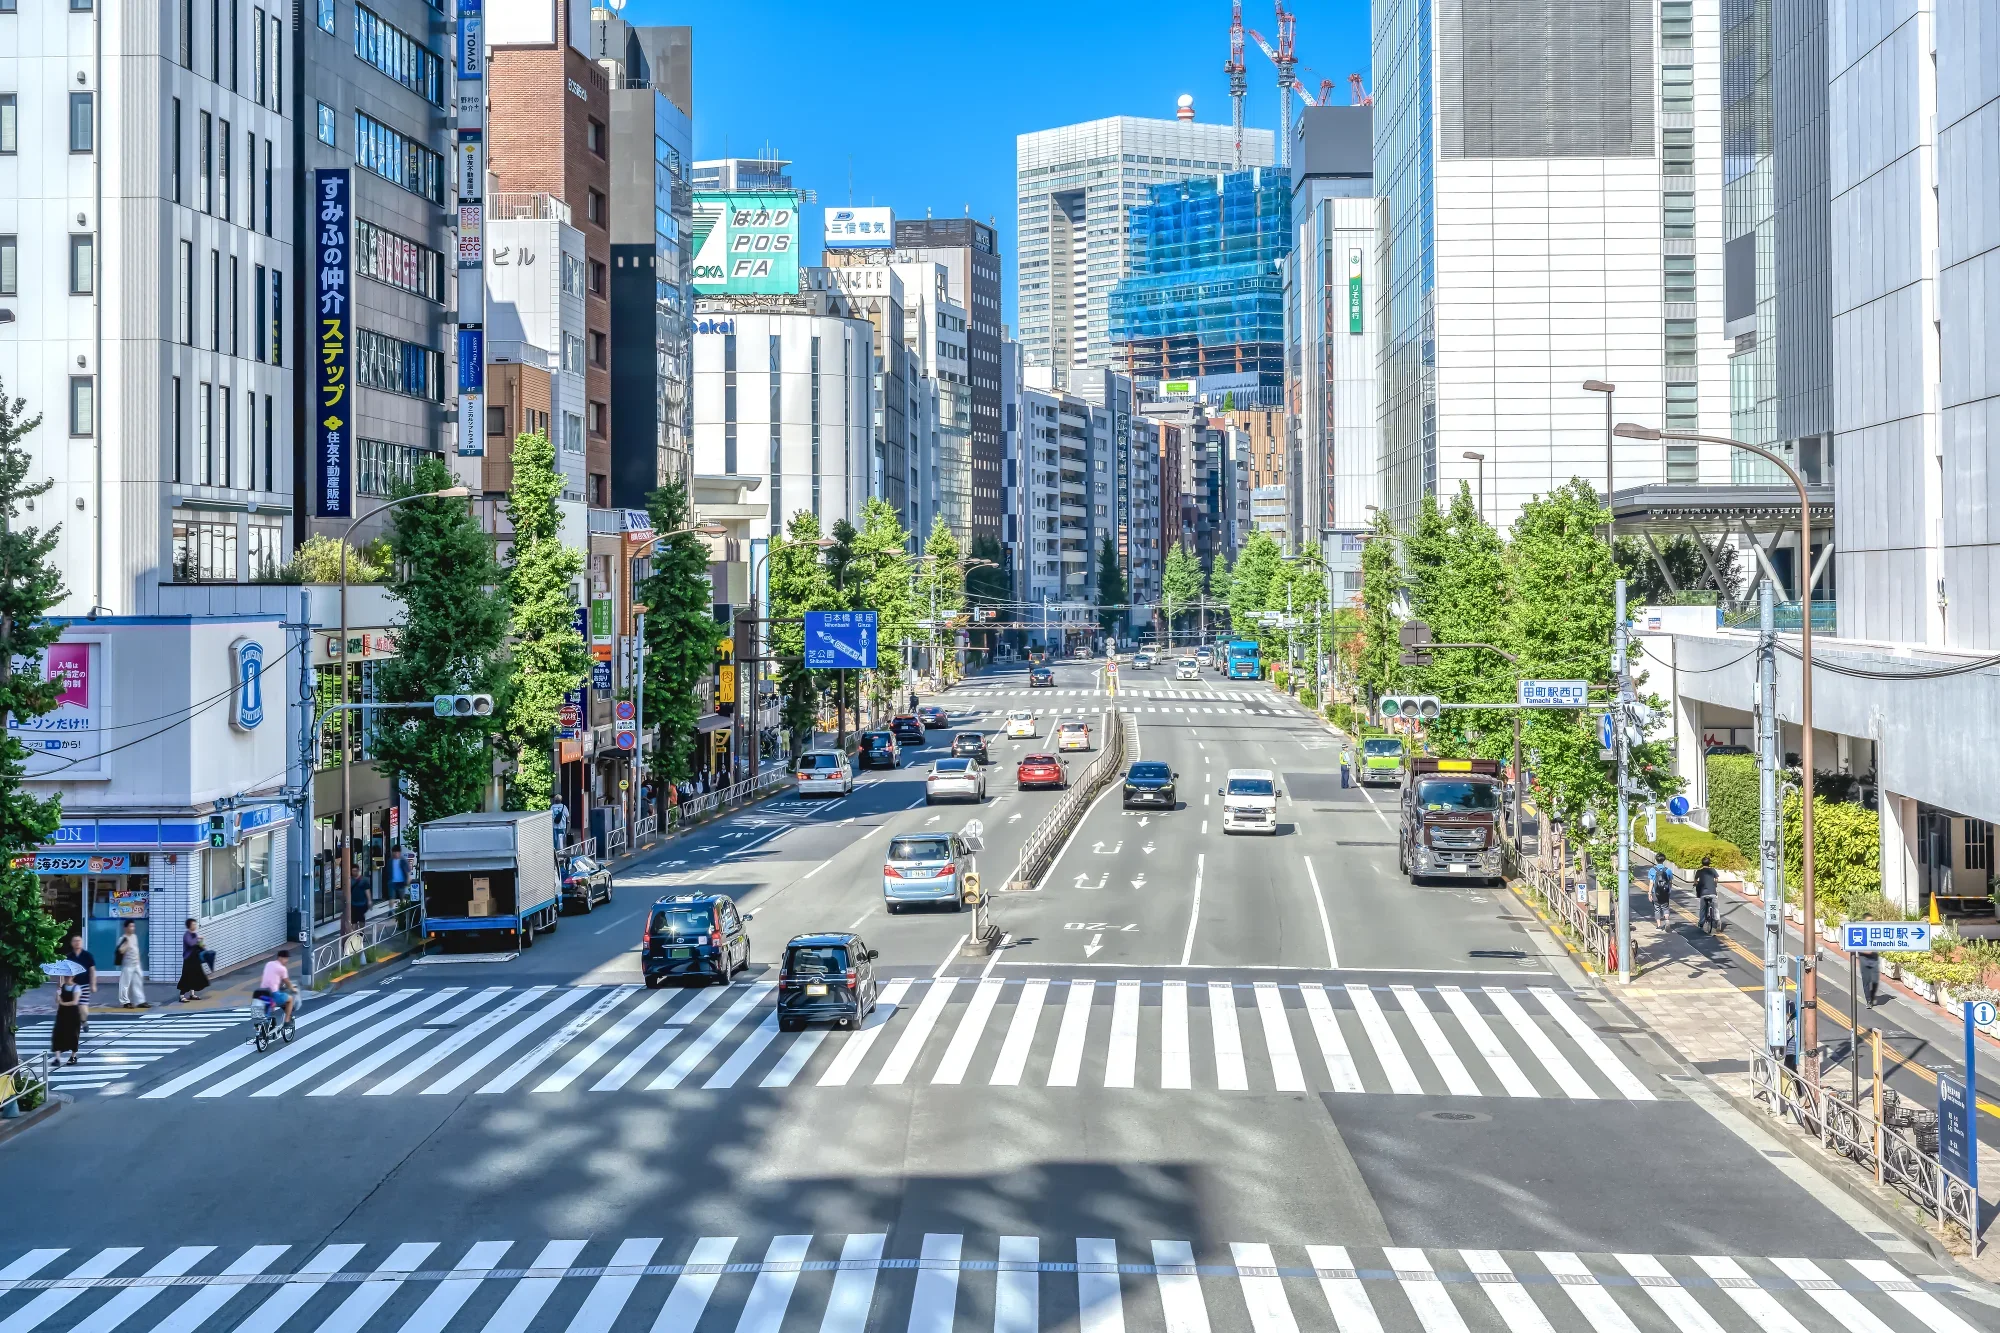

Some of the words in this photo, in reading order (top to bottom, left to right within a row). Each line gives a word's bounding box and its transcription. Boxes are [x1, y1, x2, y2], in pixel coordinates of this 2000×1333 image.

[467, 32, 476, 70] TOMAS
[732, 210, 789, 226] はかり
[831, 222, 886, 234] 三信電気
[320, 176, 344, 314] すみふの仲介
[460, 243, 481, 252] ECC
[734, 236, 790, 251] POS
[492, 246, 536, 266] ビル
[734, 260, 768, 276] FA
[1351, 284, 1360, 320] りそな銀行
[322, 319, 345, 407] ステップ
[326, 431, 340, 511] 住友不動産販売
[824, 613, 850, 622] 日本橋
[854, 613, 874, 622] 銀座
[808, 650, 835, 658] 芝公園
[1524, 687, 1582, 697] 田町駅西口
[9, 718, 88, 729] ローソンだけ!!
[61, 740, 81, 749] から!
[36, 858, 86, 870] 海からクン
[1064, 922, 1140, 932] 7-20
[1870, 927, 1908, 939] 田町駅
